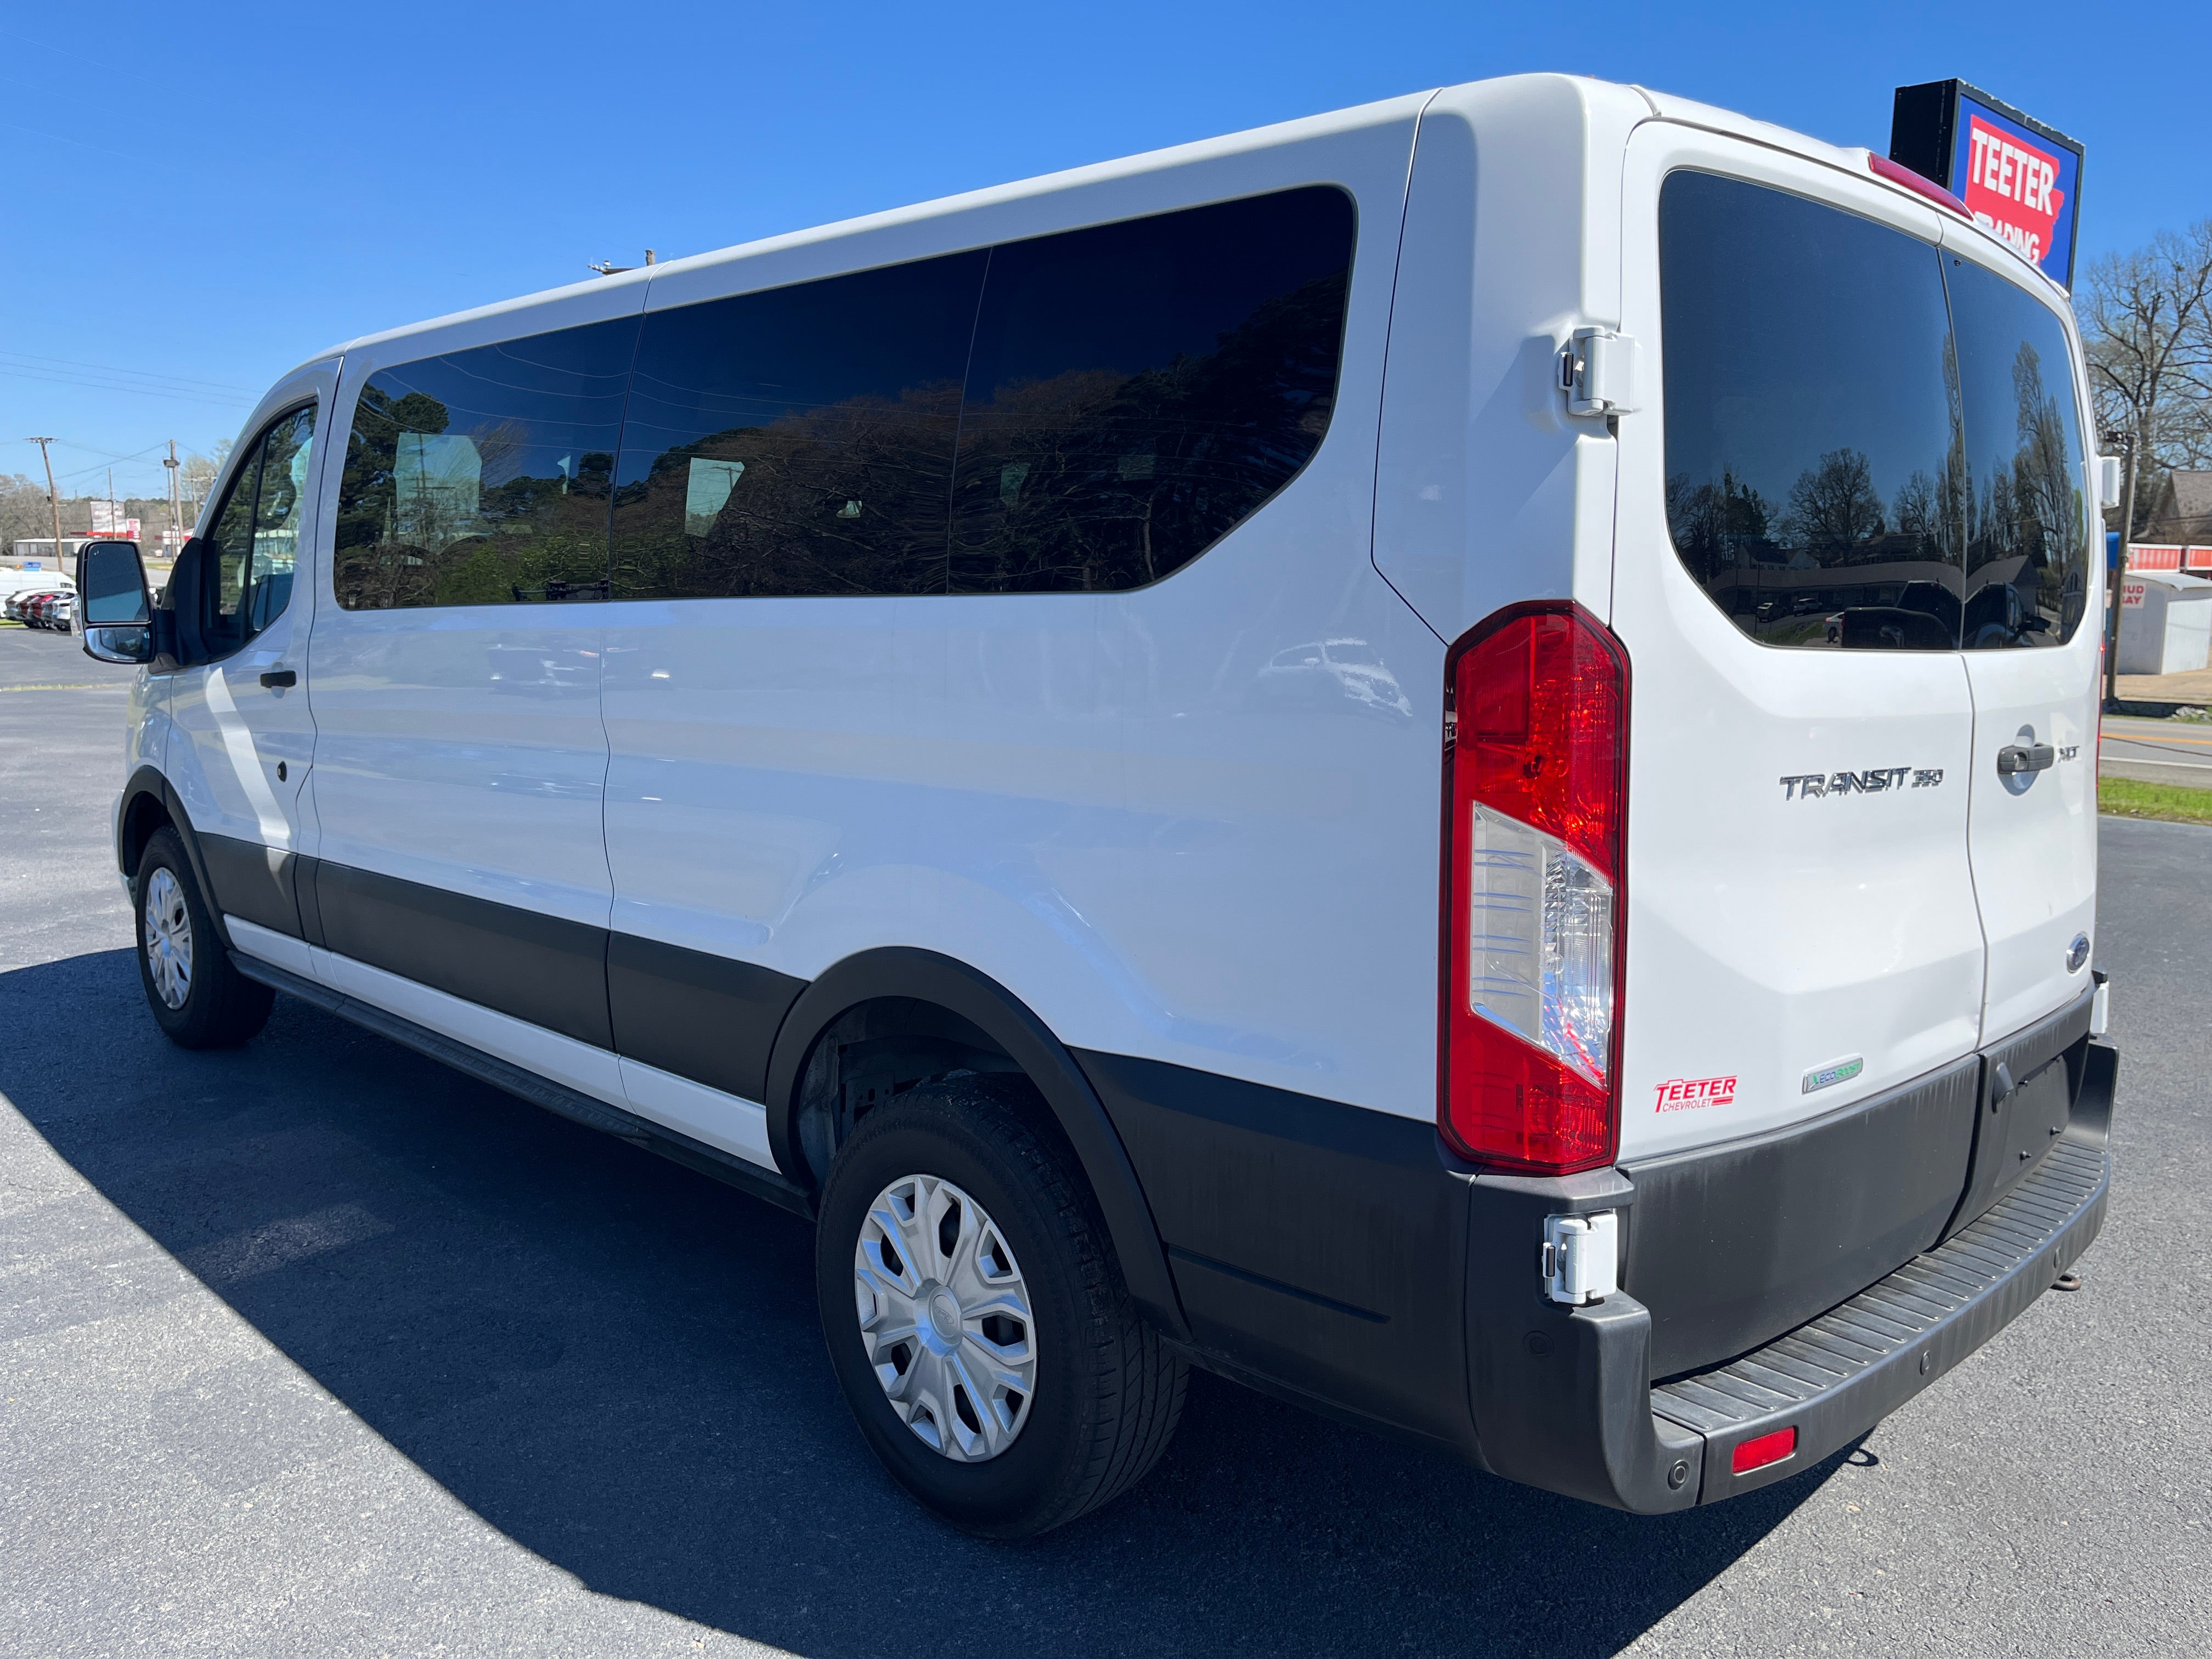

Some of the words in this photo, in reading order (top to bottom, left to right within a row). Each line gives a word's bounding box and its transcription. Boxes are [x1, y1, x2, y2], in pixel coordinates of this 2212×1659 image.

[1972, 127, 2053, 216] TEETER
[1974, 211, 2040, 264] DING
[1780, 766, 1912, 801] TRANSIT
[1654, 1078, 1737, 1113] TEETER
[1662, 1098, 1712, 1112] CHEVROLET
